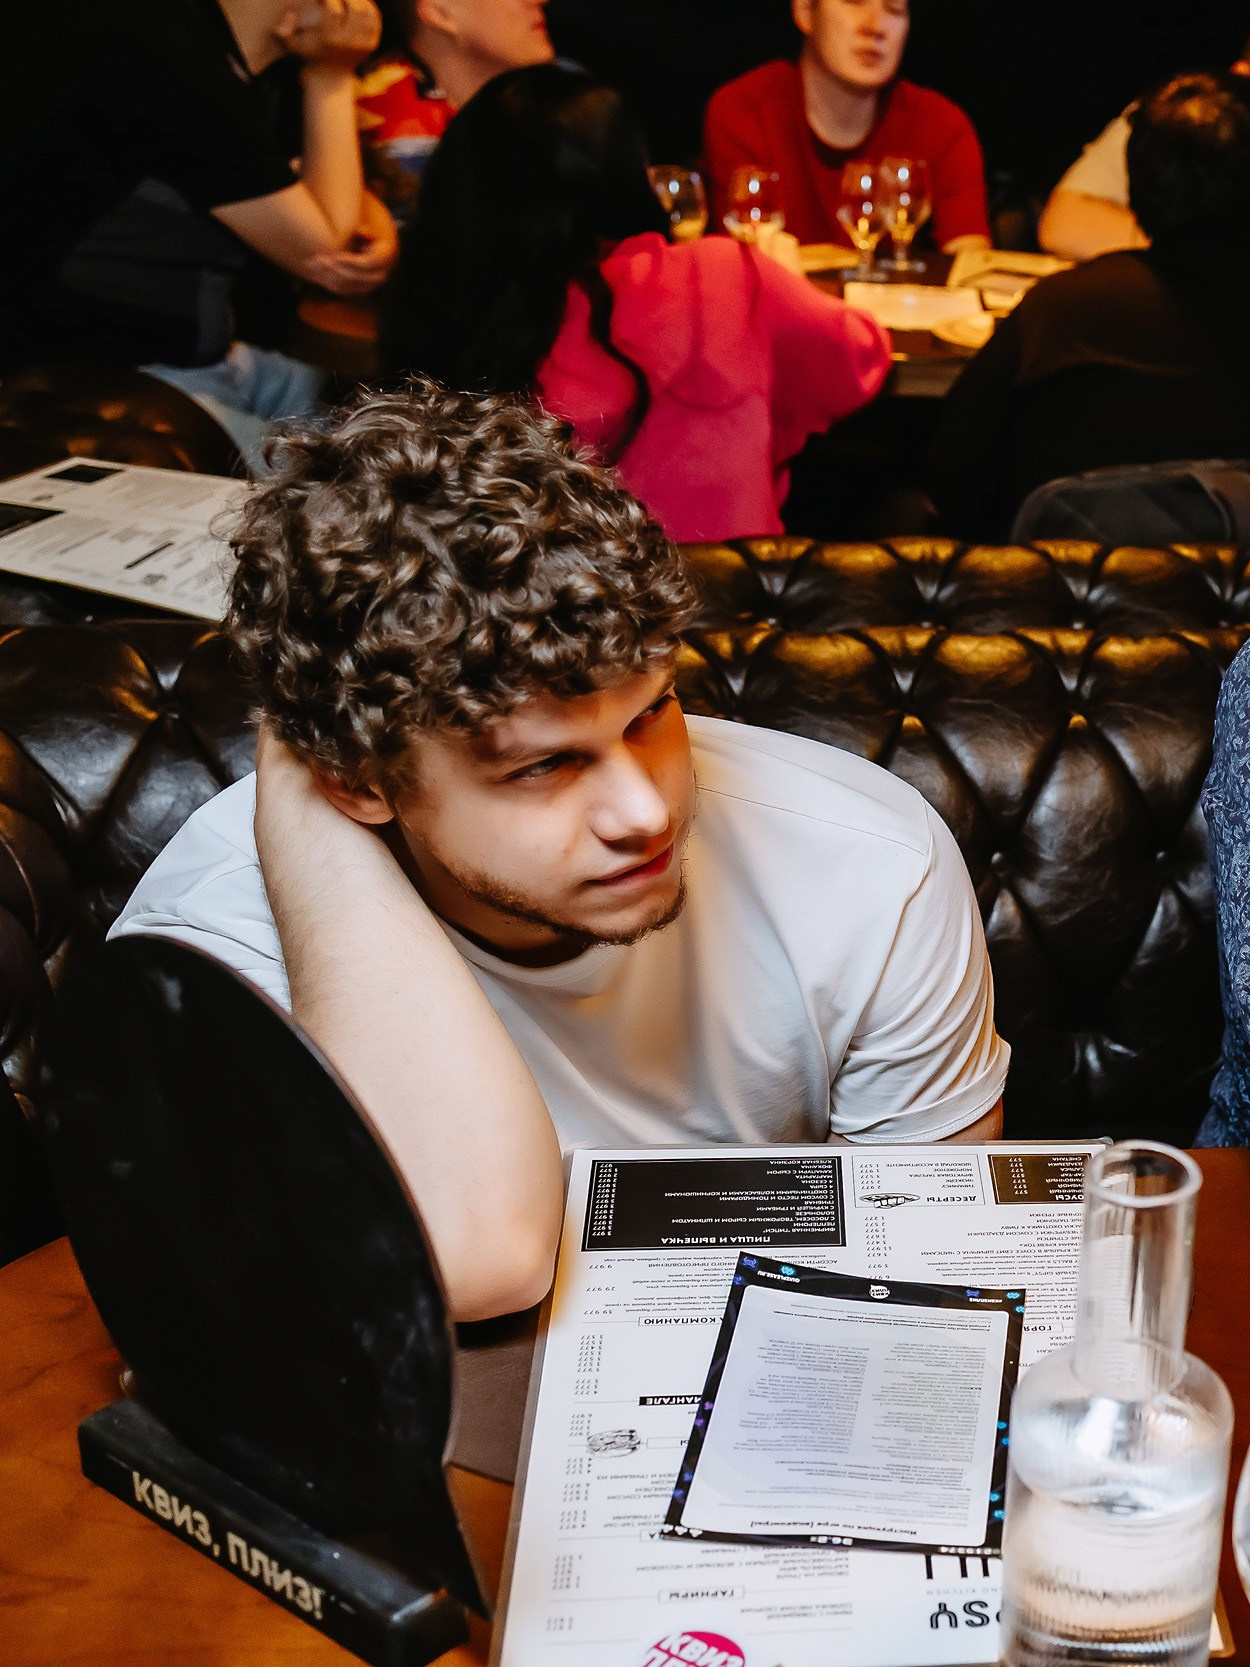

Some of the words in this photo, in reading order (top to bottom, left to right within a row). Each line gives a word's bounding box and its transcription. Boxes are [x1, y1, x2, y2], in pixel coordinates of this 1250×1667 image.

[644, 1317, 716, 1325] КОМПАНИЮ
[857, 1526, 917, 1535] Инструкция
[133, 1471, 220, 1558] КВИЗ,
[227, 1532, 325, 1620] ПЛИЗ!
[669, 1590, 734, 1599] ГАРНИРЫ
